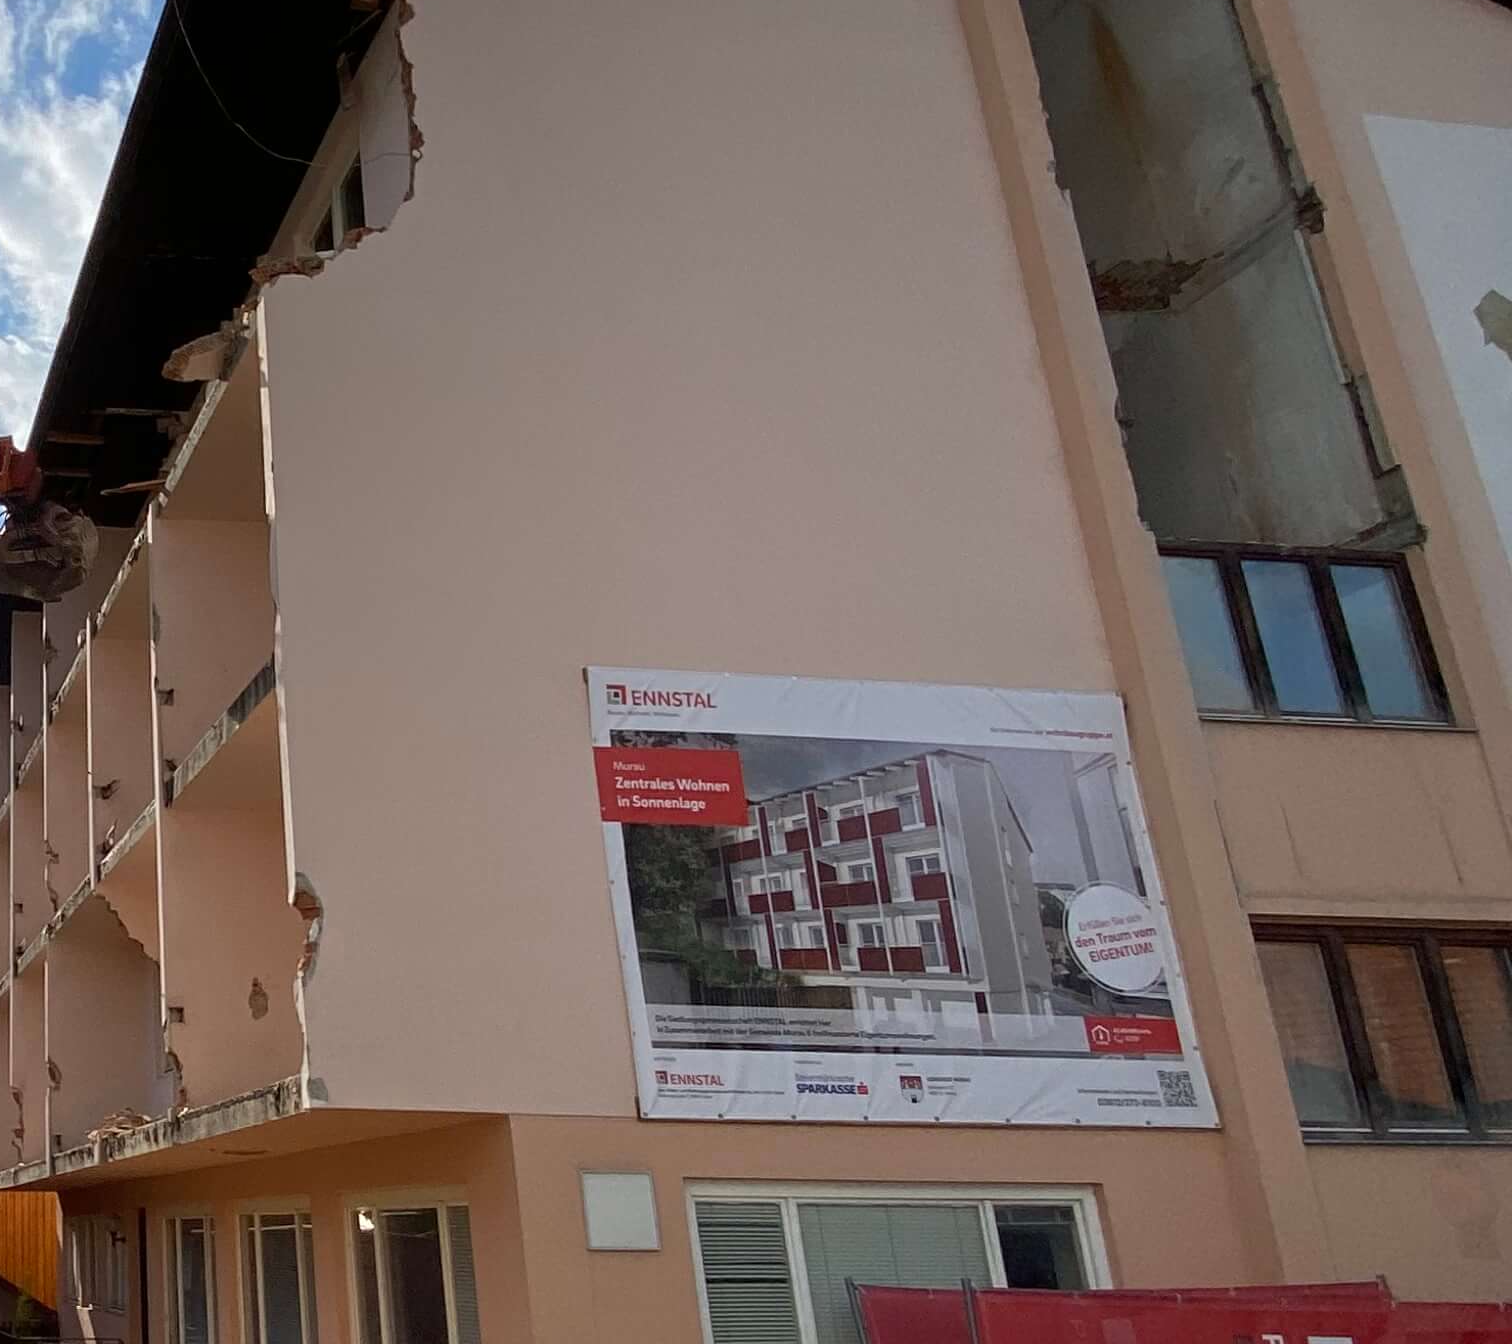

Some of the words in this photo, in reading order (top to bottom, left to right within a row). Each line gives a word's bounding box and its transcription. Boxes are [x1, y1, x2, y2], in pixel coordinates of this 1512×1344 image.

[631, 689, 718, 709] ENNSTAL
[614, 776, 675, 791] Zentrales
[676, 778, 730, 792] Wohnen
[617, 795, 630, 808] in
[632, 795, 706, 812] Sonnenlage
[1074, 937, 1096, 948] den
[1096, 931, 1132, 945] Traum
[1132, 927, 1157, 939] vom
[669, 1073, 726, 1087] ENNSTAL
[796, 1083, 857, 1095] SPARKASSE
